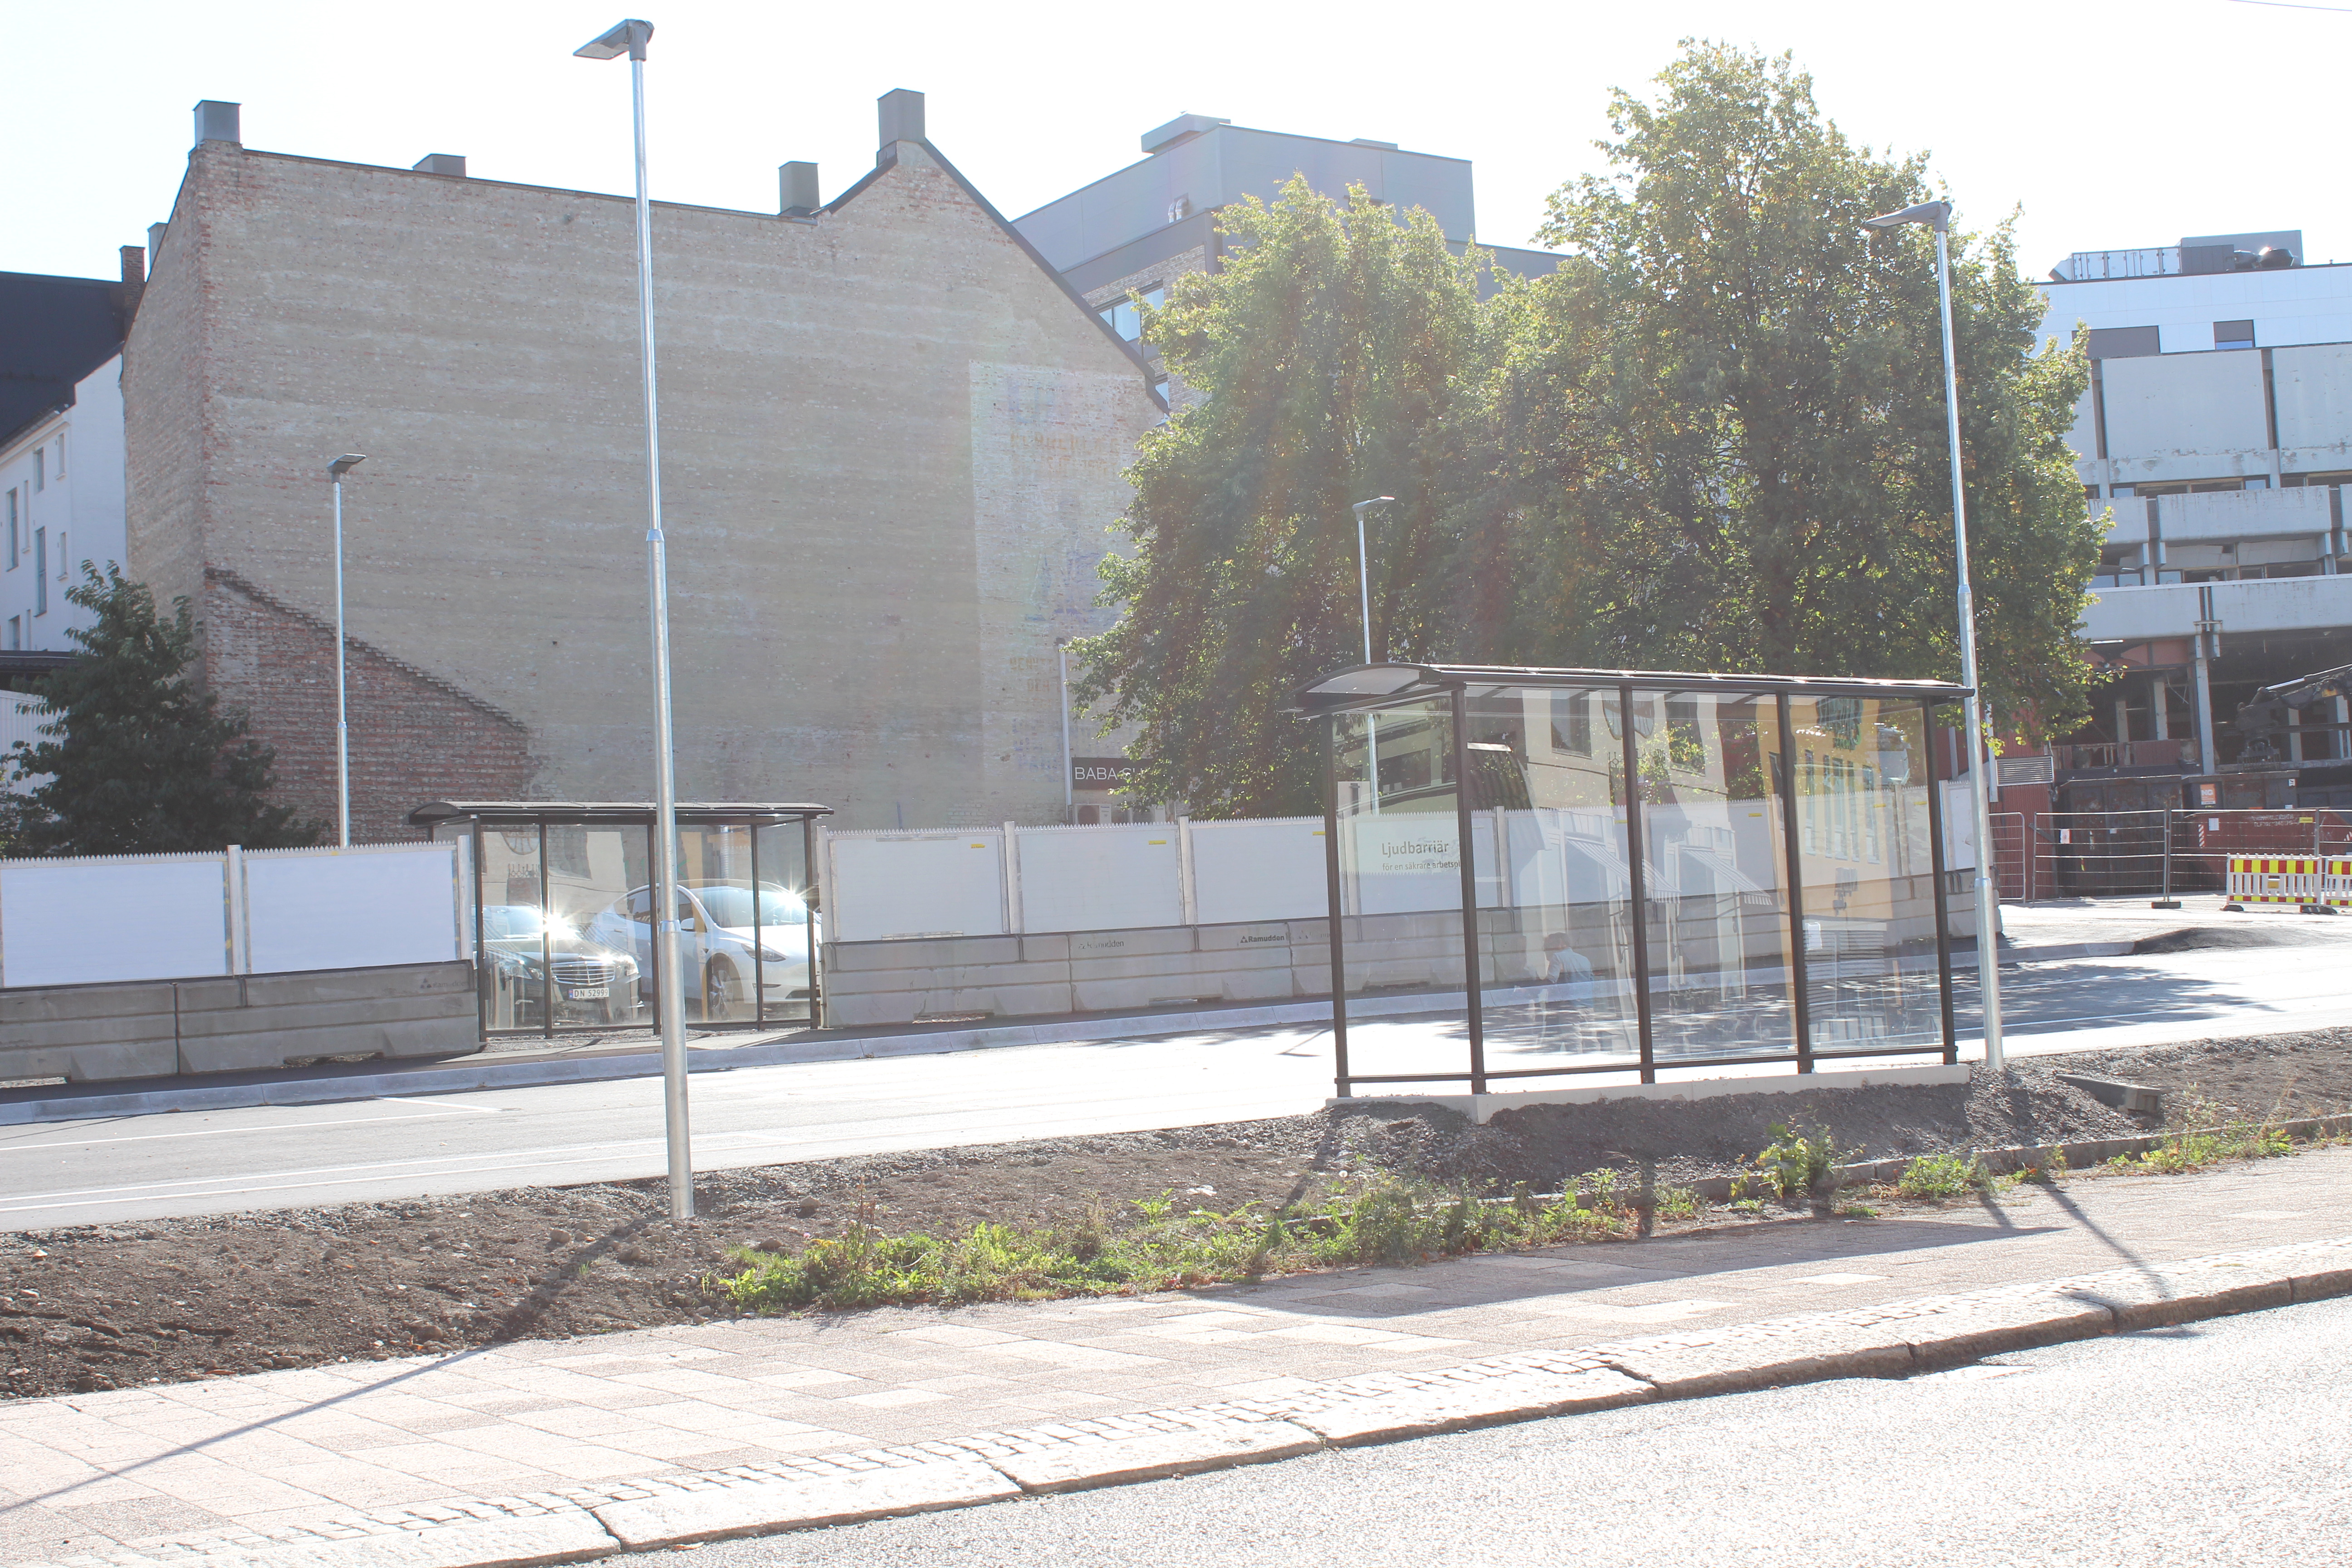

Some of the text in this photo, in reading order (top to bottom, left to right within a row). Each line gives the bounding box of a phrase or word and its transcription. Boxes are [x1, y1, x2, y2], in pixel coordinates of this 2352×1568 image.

[1074, 767, 1118, 780] BABA
[1382, 840, 1449, 858] Ljudbarriär
[1432, 860, 1460, 869] arbetspl
[588, 989, 608, 997] 52999
